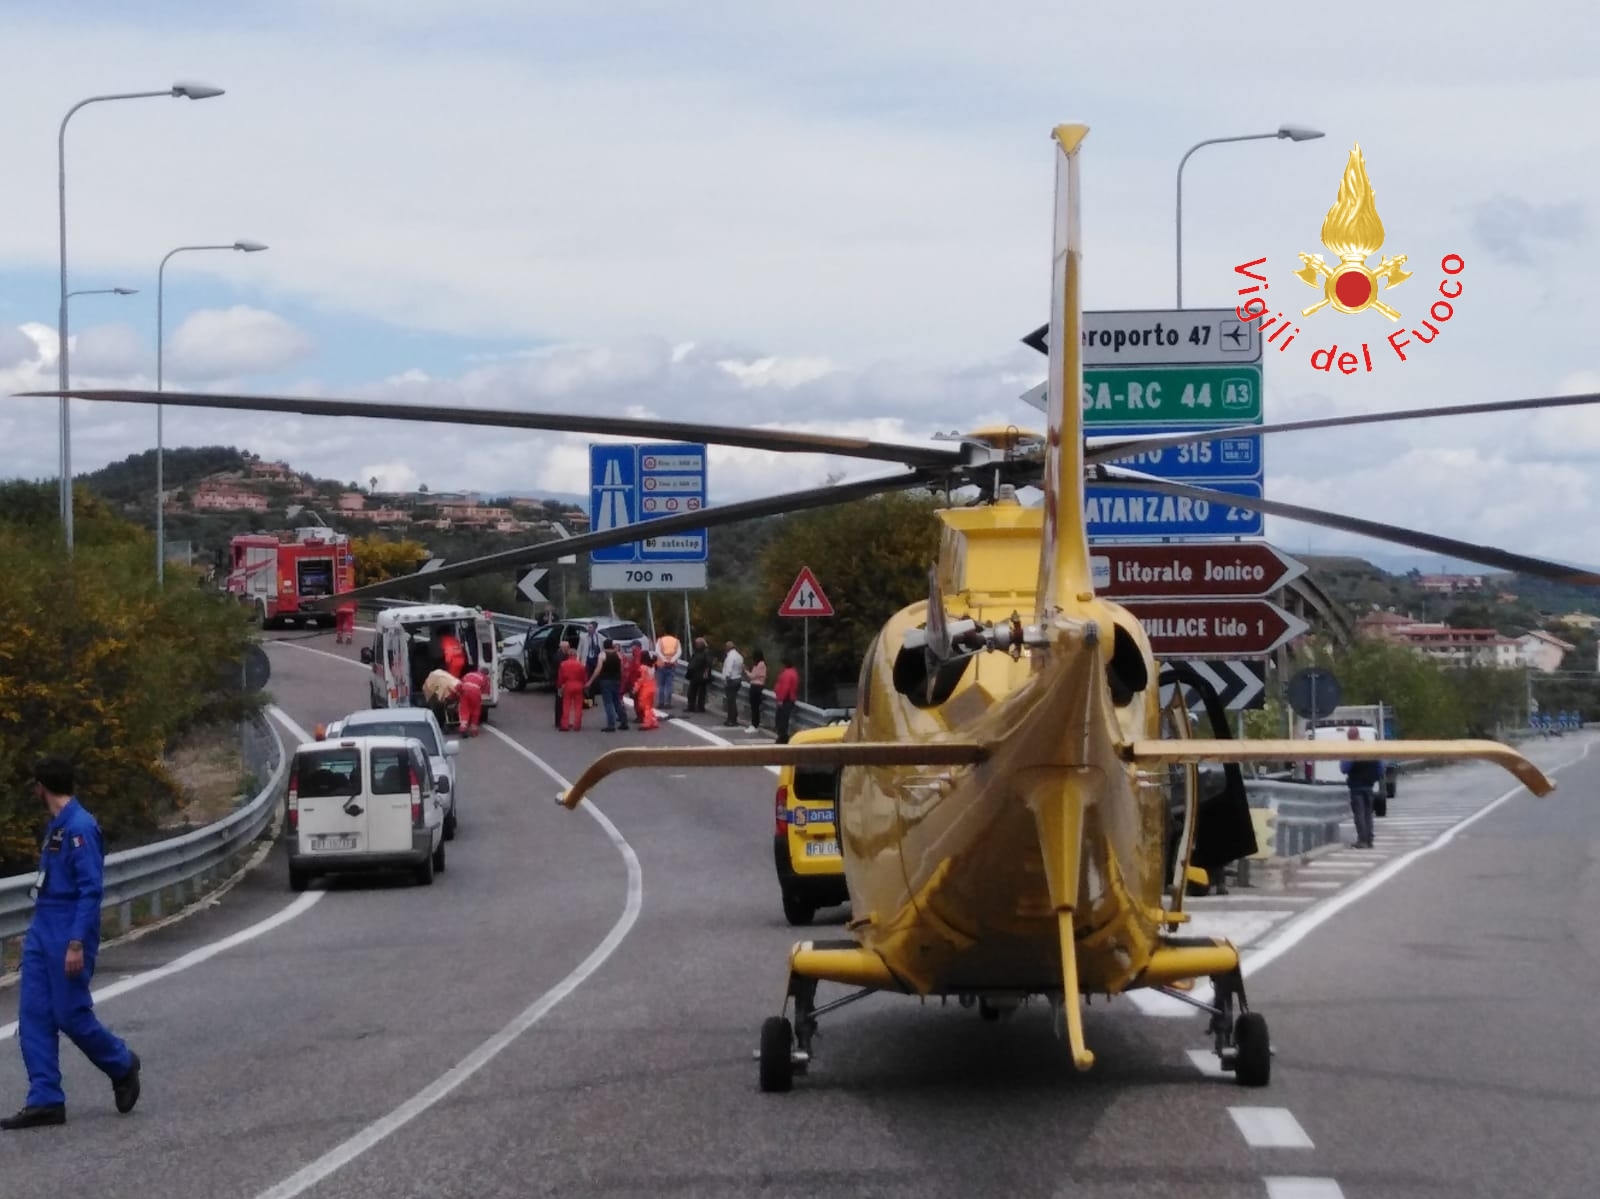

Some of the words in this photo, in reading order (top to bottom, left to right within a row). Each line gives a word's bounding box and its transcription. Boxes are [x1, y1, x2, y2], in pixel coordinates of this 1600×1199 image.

[1081, 323, 1179, 352] roporto
[1189, 326, 1211, 346] 47
[1083, 382, 1162, 410] SA-RC
[1180, 383, 1212, 408] 44
[1225, 384, 1249, 404] A3
[1177, 441, 1212, 464] 315
[1085, 496, 1210, 523] ATANZARO
[625, 571, 654, 583] 700
[660, 573, 673, 582] m
[1117, 560, 1193, 583] Litorale
[1203, 559, 1265, 581] Jonico
[1141, 618, 1208, 637] UILLACE
[1214, 617, 1248, 637] Lido
[1256, 619, 1264, 636] 1
